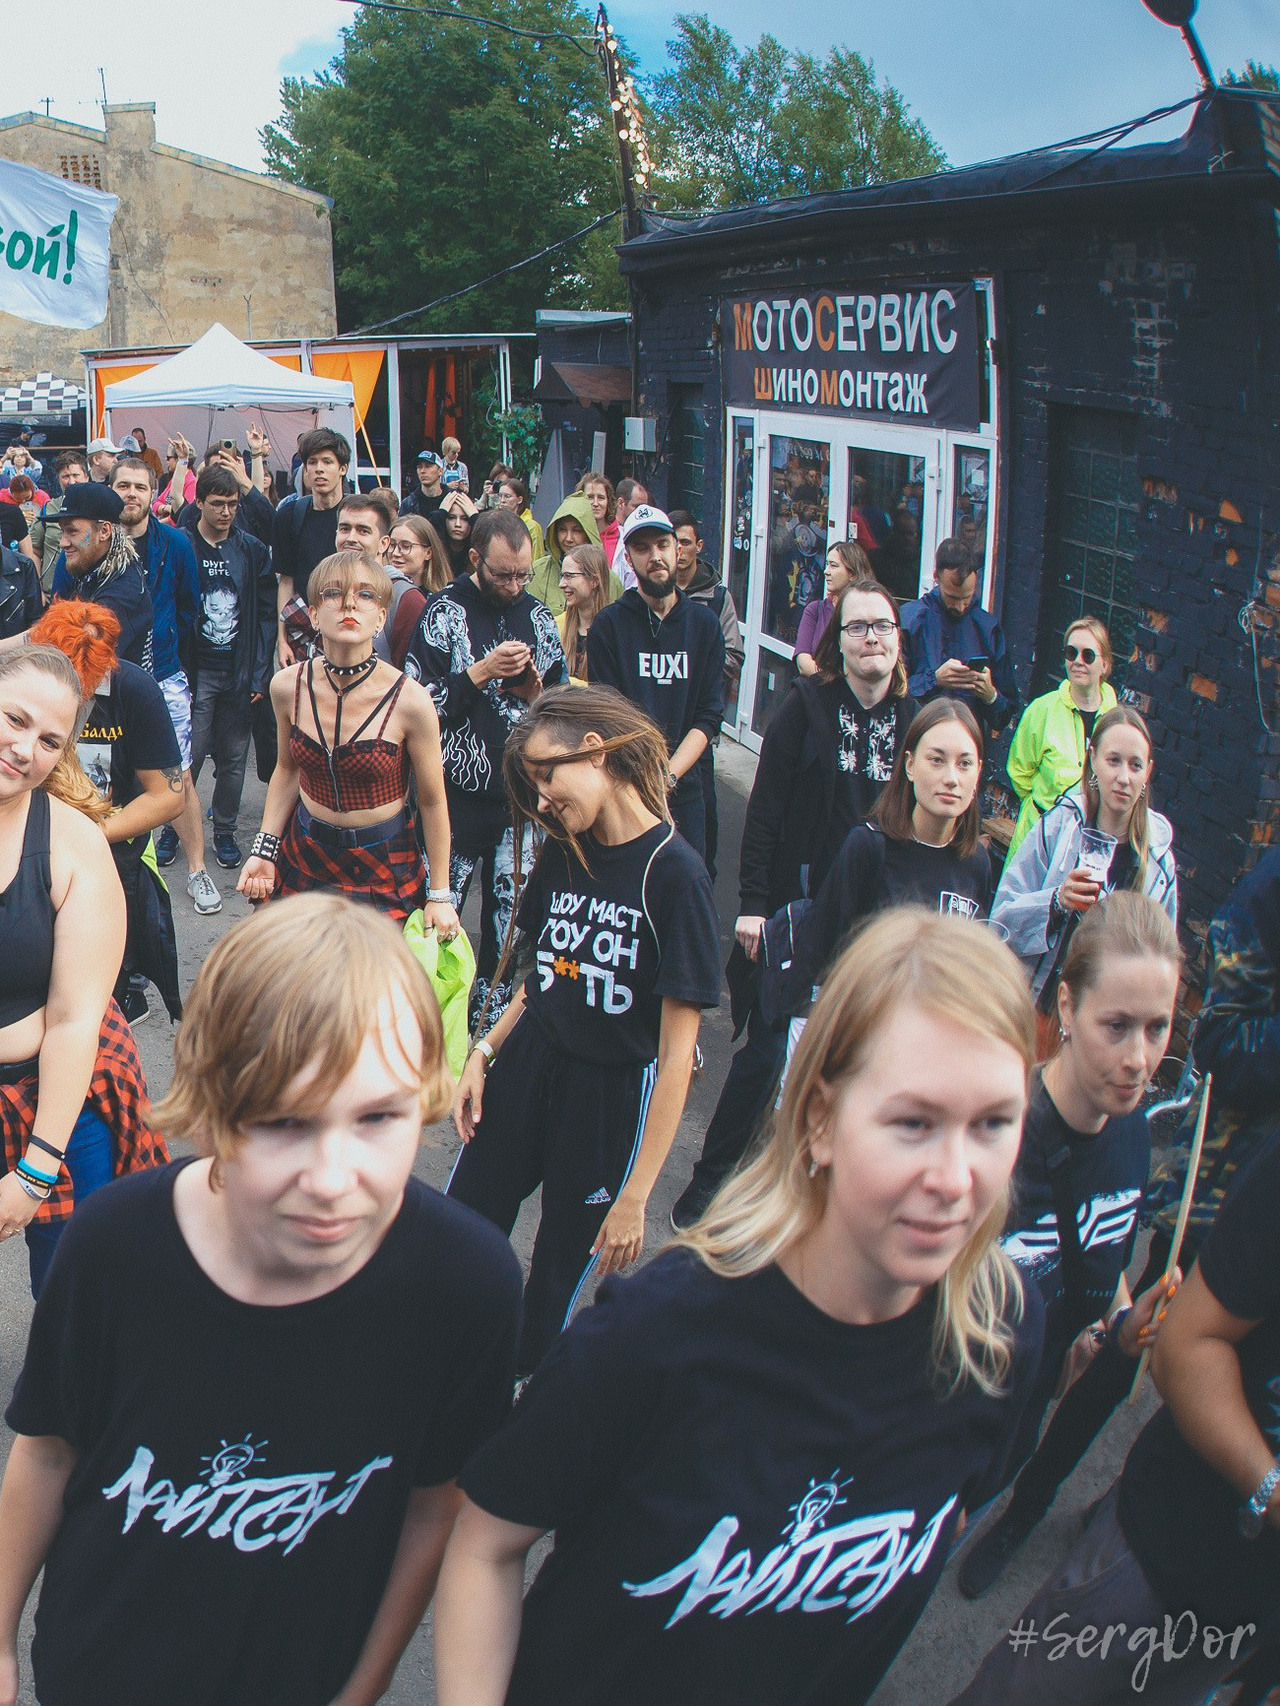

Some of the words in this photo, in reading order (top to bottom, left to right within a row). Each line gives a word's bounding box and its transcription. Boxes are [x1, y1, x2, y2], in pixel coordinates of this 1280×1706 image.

[733, 290, 958, 354] МОТОСЕРВИС
[588, 898, 642, 932] МАСТ
[538, 918, 591, 953] ГОУ
[593, 930, 639, 969] ОН
